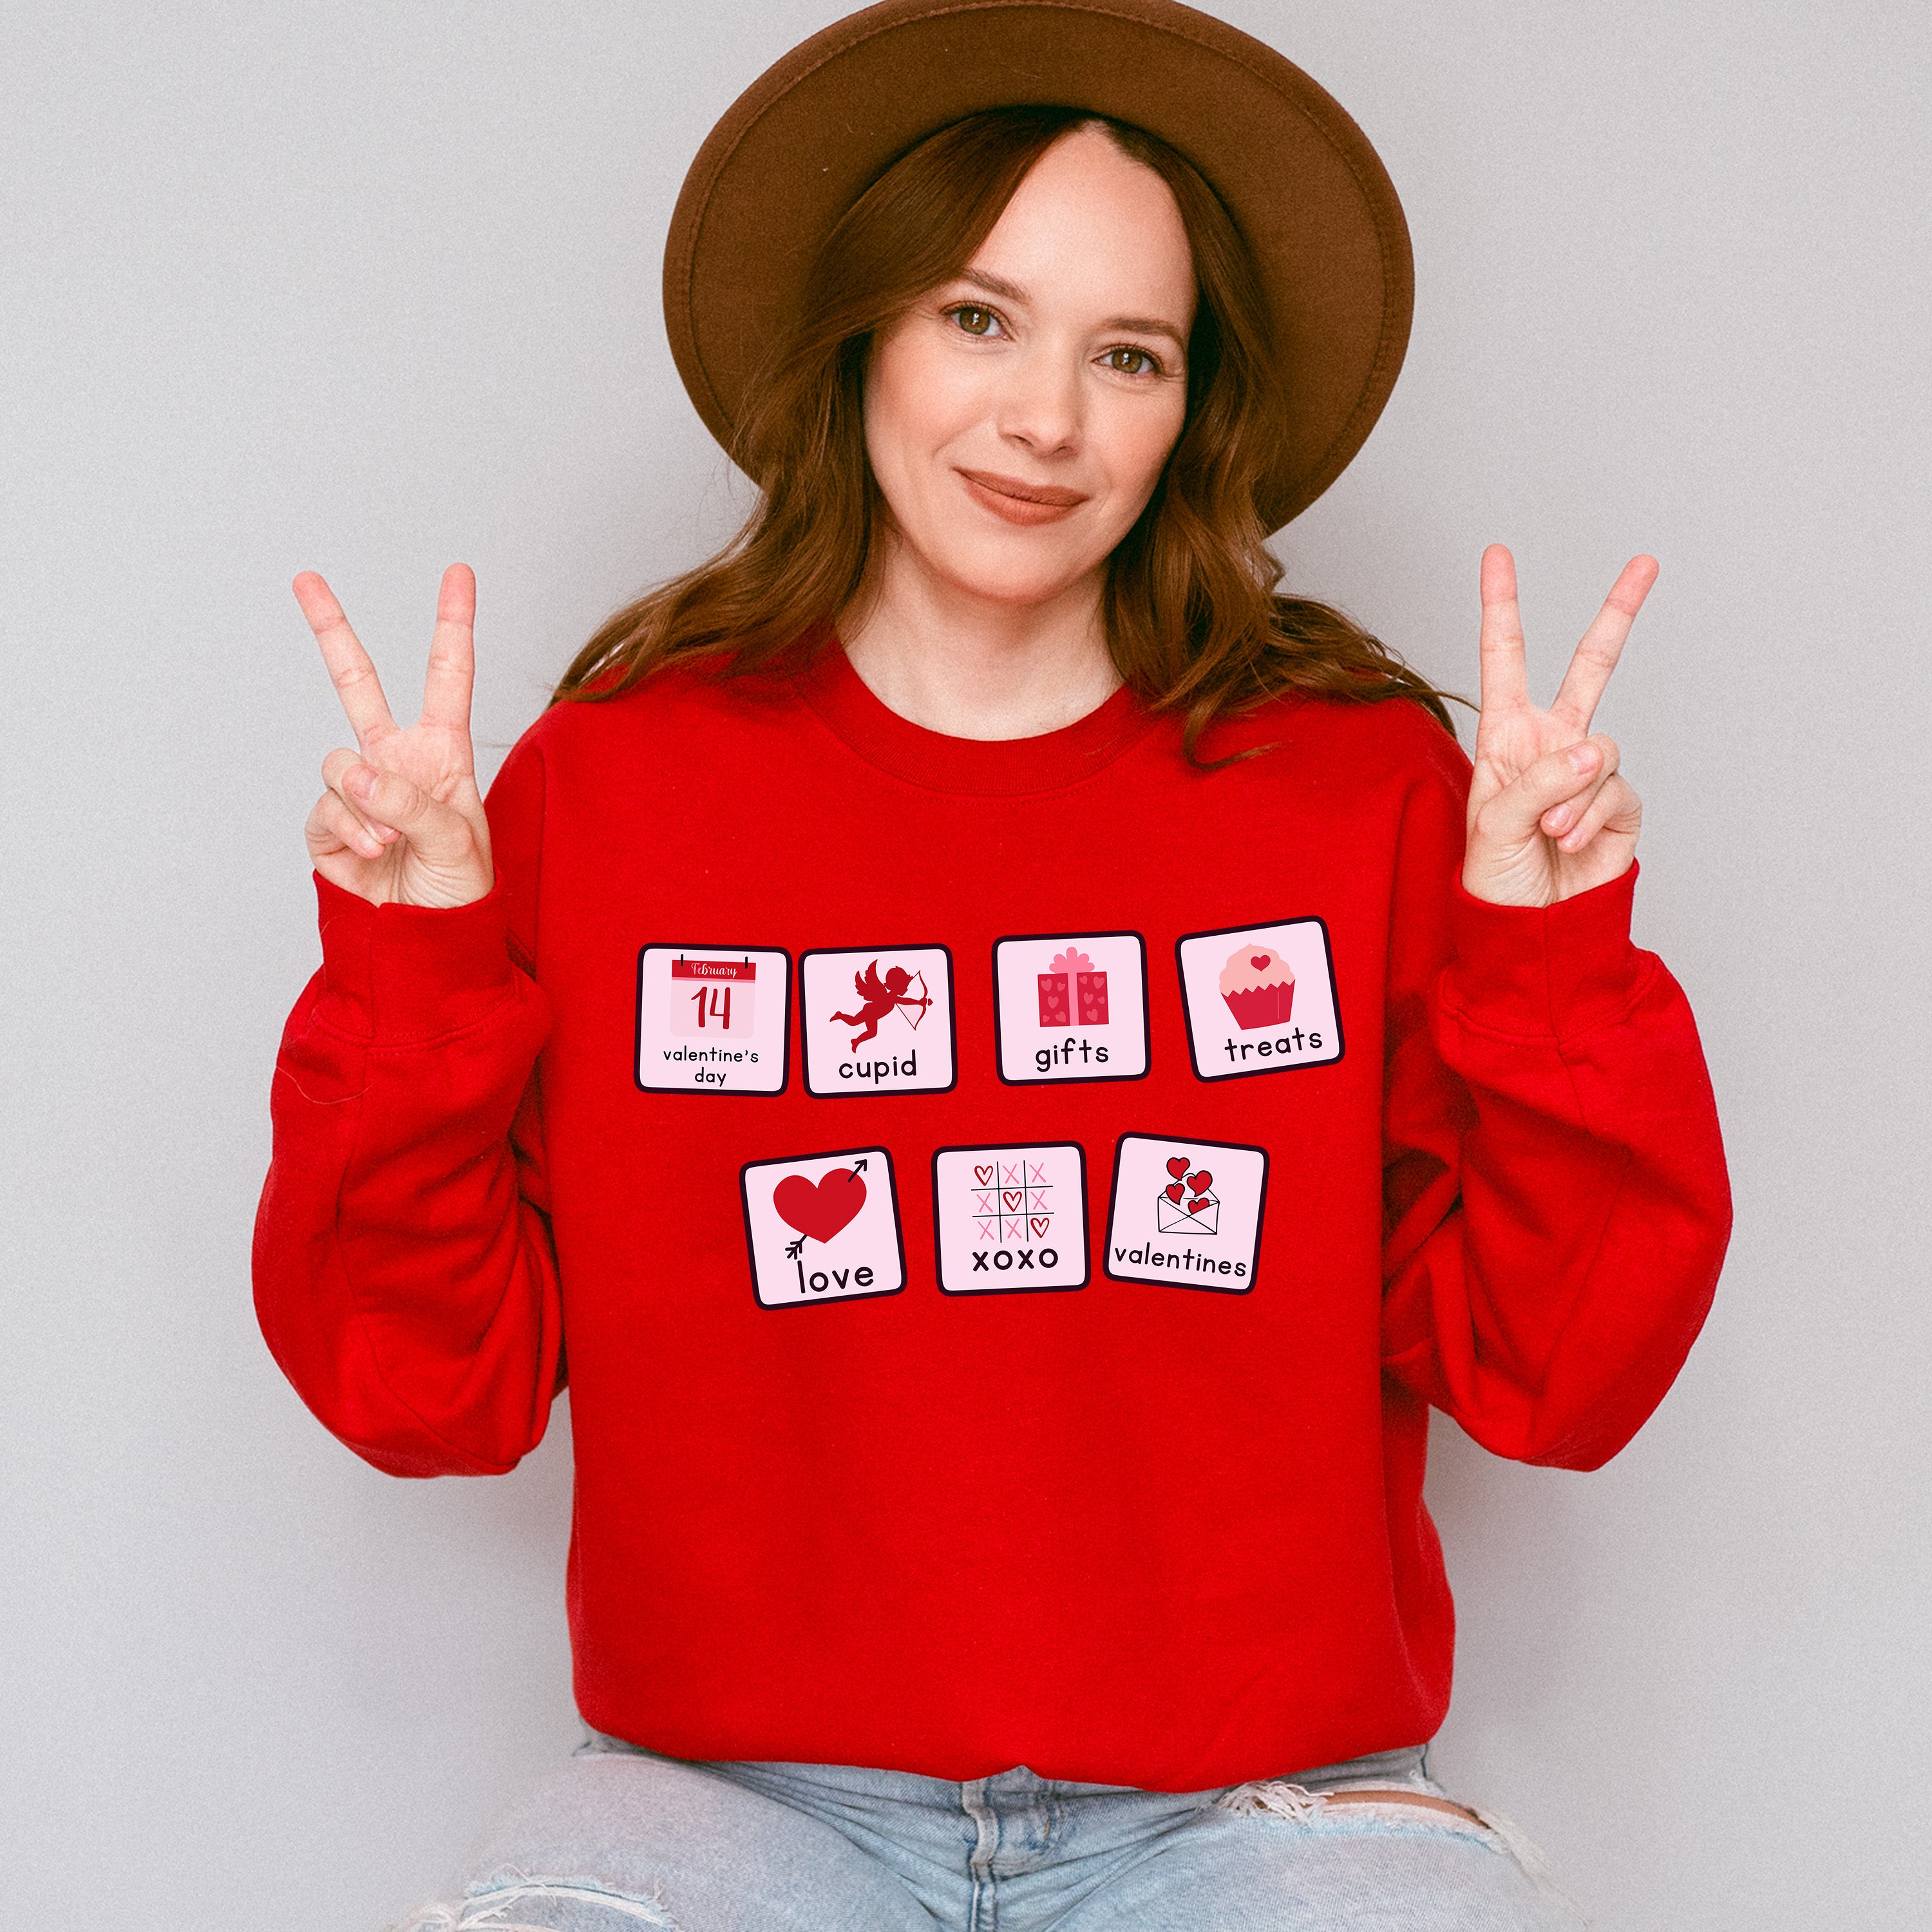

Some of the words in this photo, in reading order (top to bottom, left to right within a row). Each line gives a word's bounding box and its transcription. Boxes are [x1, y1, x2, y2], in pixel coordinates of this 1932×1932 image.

[690, 963, 737, 979] February
[690, 986, 731, 1030] 14
[663, 1045, 759, 1063] valentine's
[1035, 1037, 1109, 1073] gifts
[1224, 1027, 1323, 1062] treats
[694, 1066, 726, 1087] day
[838, 1049, 917, 1084] cupid
[797, 1260, 874, 1294] love
[972, 1248, 1059, 1272] xoxo
[1115, 1242, 1247, 1278] valentines
